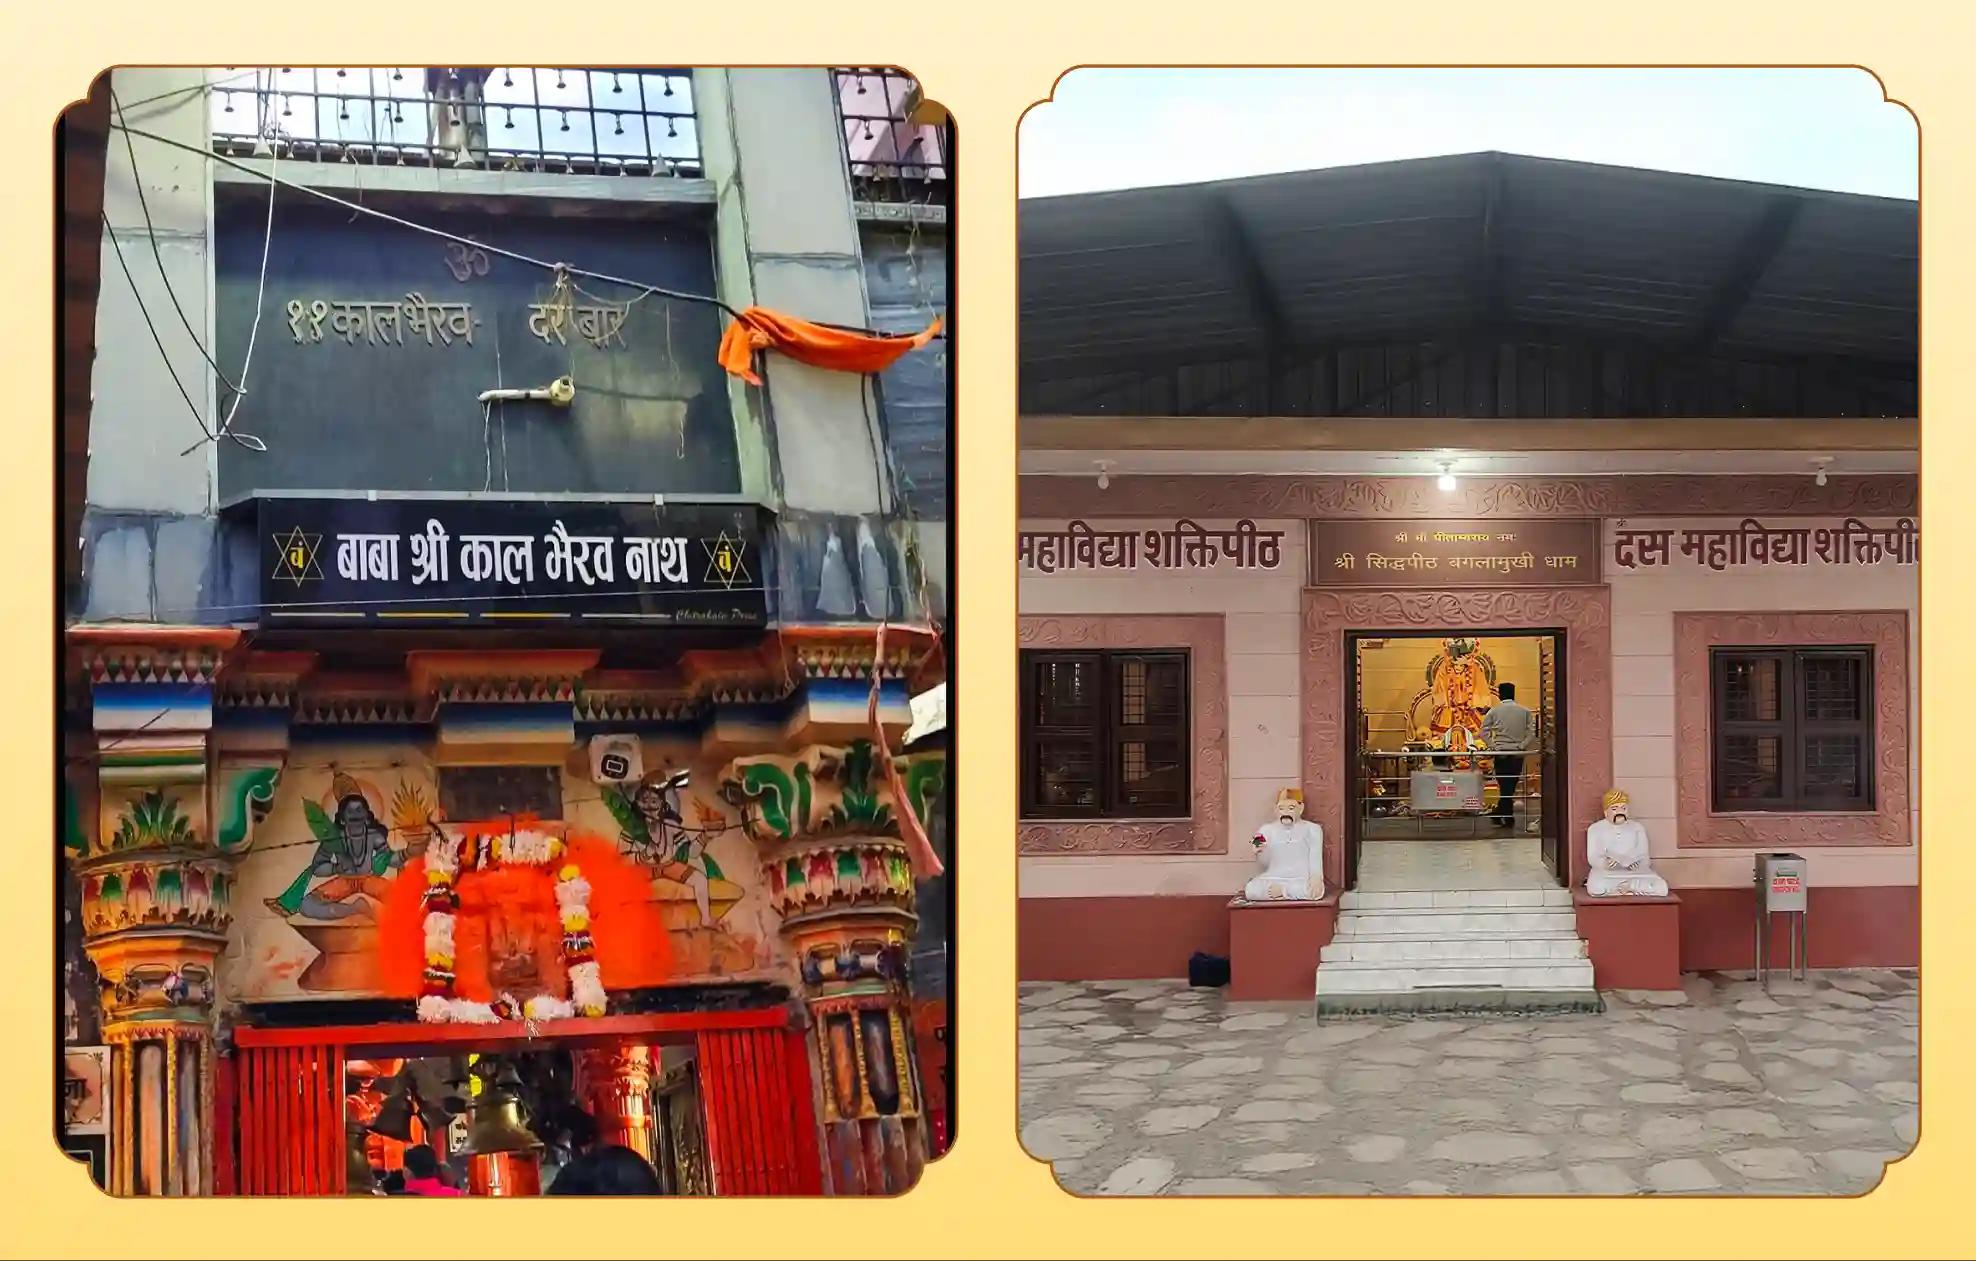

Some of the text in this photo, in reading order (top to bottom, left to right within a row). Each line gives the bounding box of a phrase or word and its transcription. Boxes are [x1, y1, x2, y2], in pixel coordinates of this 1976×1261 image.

[337, 518, 689, 585] बाबा श्री काल भैरव नाथ
[1144, 519, 1285, 569] शक्तिपीठ
[1334, 553, 1355, 569] श्री
[1366, 552, 1440, 571] सिद्धपीठ
[1544, 555, 1578, 569] धाम
[1680, 519, 1811, 571] महाविद्या
[1814, 518, 1920, 564] शक्तिपी
